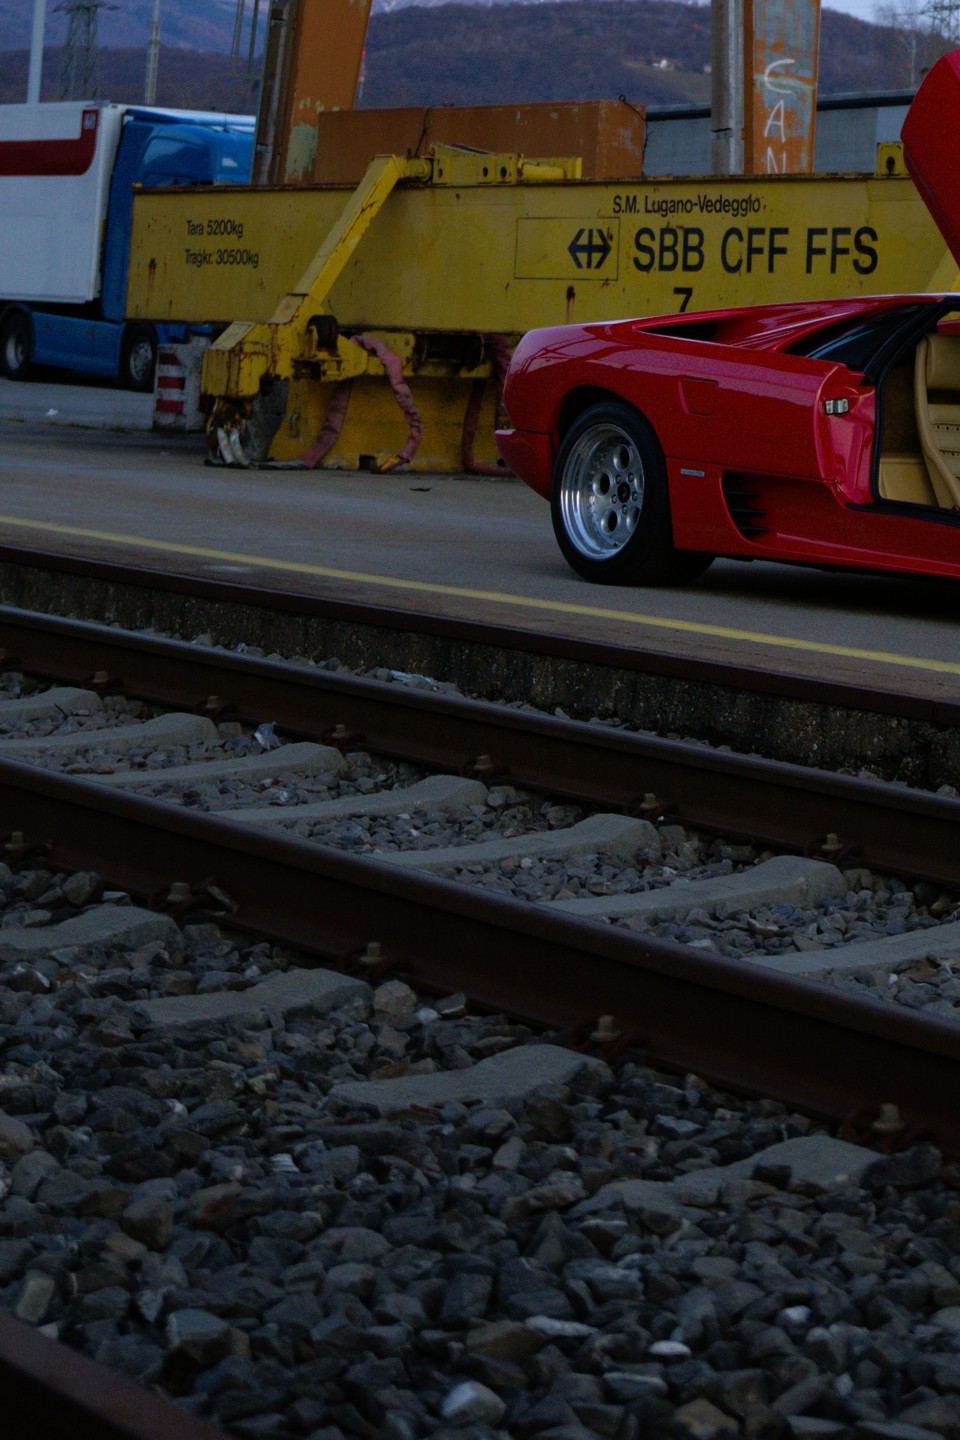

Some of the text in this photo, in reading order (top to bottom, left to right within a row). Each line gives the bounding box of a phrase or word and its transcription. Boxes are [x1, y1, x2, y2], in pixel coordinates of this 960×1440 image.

[613, 195, 639, 213] S.M.
[186, 219, 243, 238] Tara 5200kg
[216, 248, 259, 268] 30500kg
[633, 227, 878, 275] SBB CFF FFS
[673, 287, 693, 312] 7
